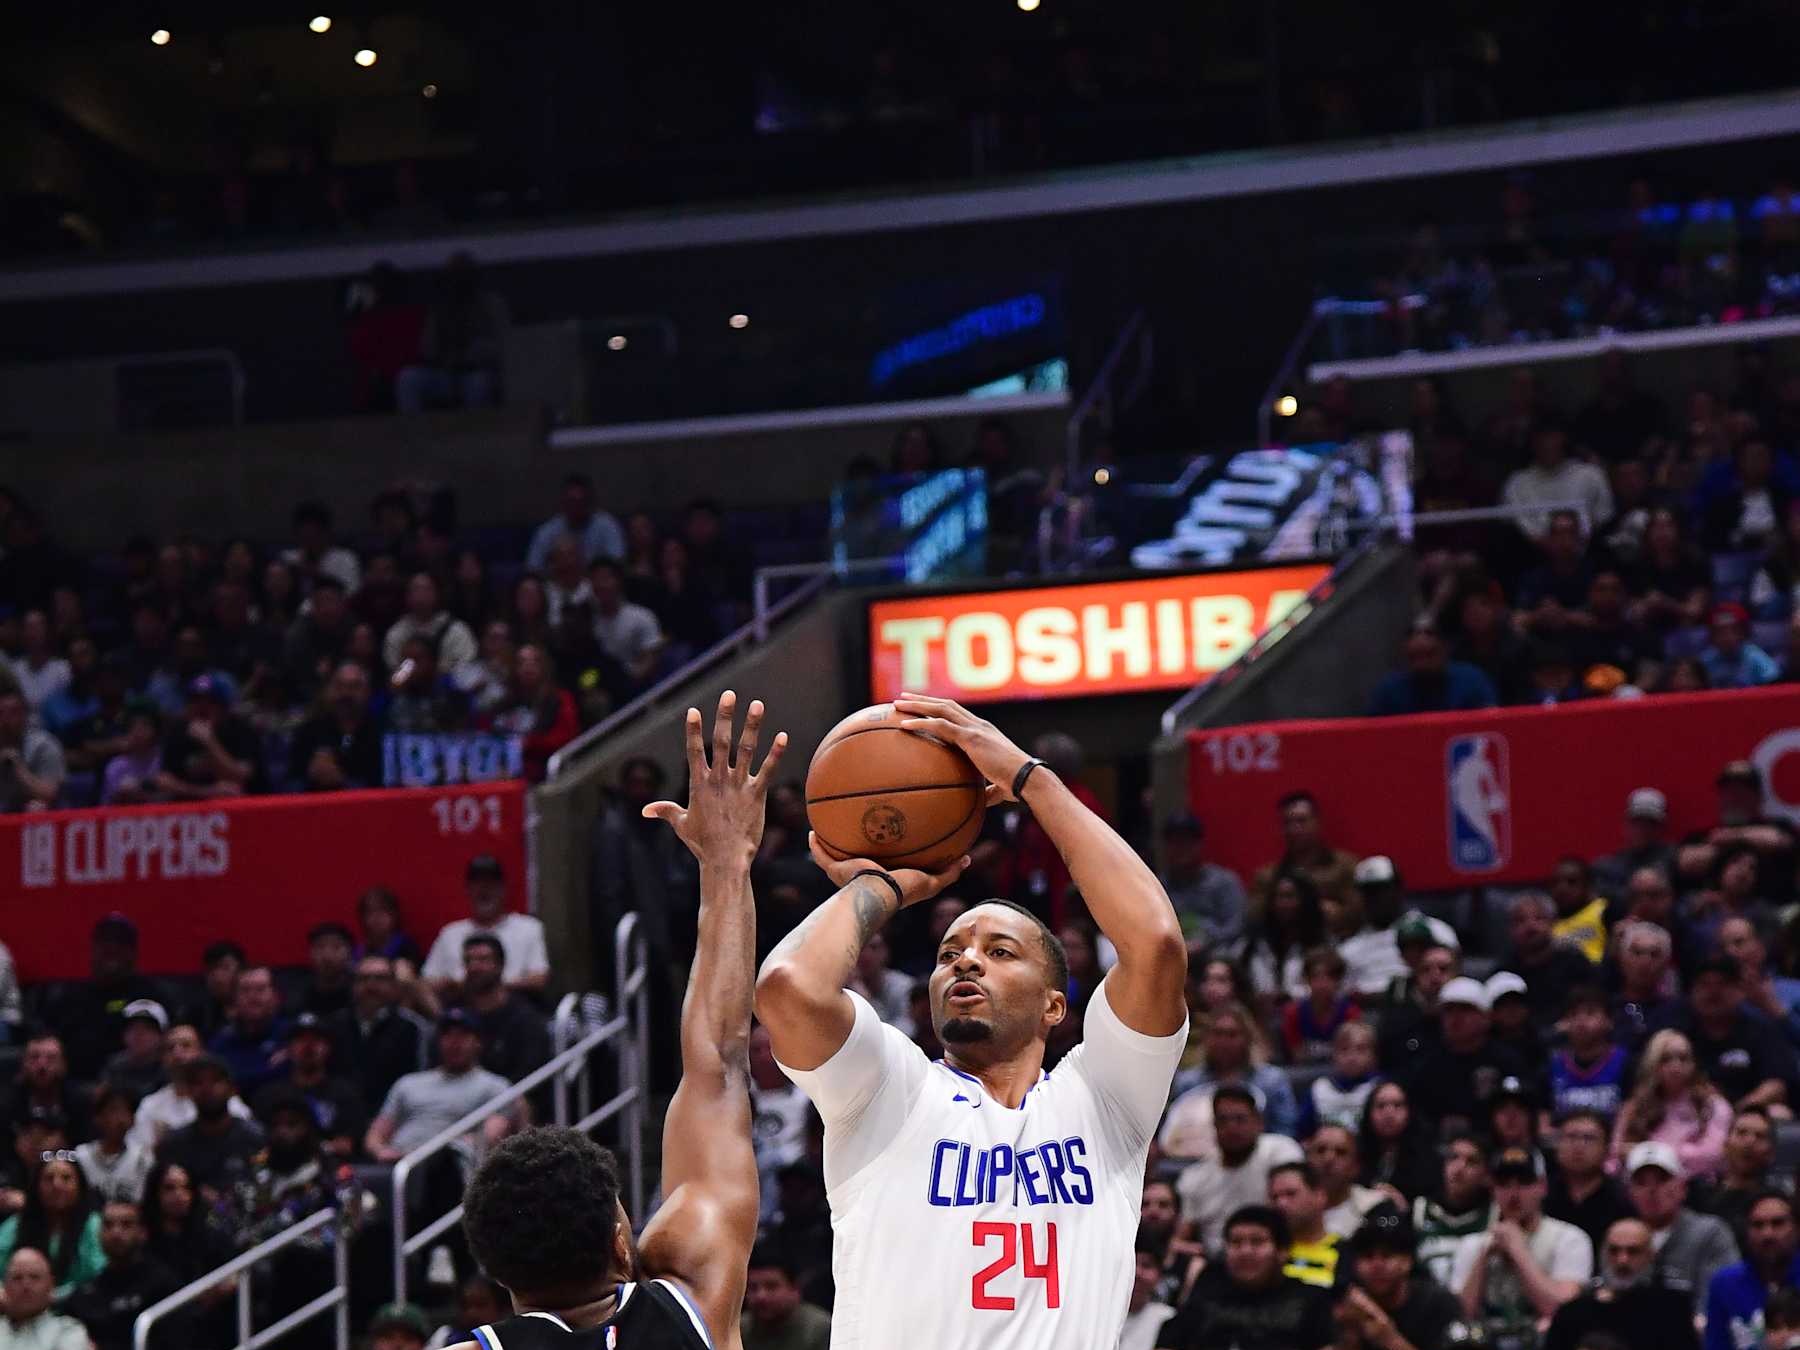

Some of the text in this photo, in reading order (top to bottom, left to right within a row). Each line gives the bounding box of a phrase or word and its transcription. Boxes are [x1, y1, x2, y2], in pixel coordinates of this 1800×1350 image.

[1202, 733, 1281, 773] 102
[65, 811, 231, 884] CLIPPERS
[431, 795, 502, 838] 101
[927, 1135, 1095, 1207] CLIPPERS
[971, 1220, 1061, 1311] 24
